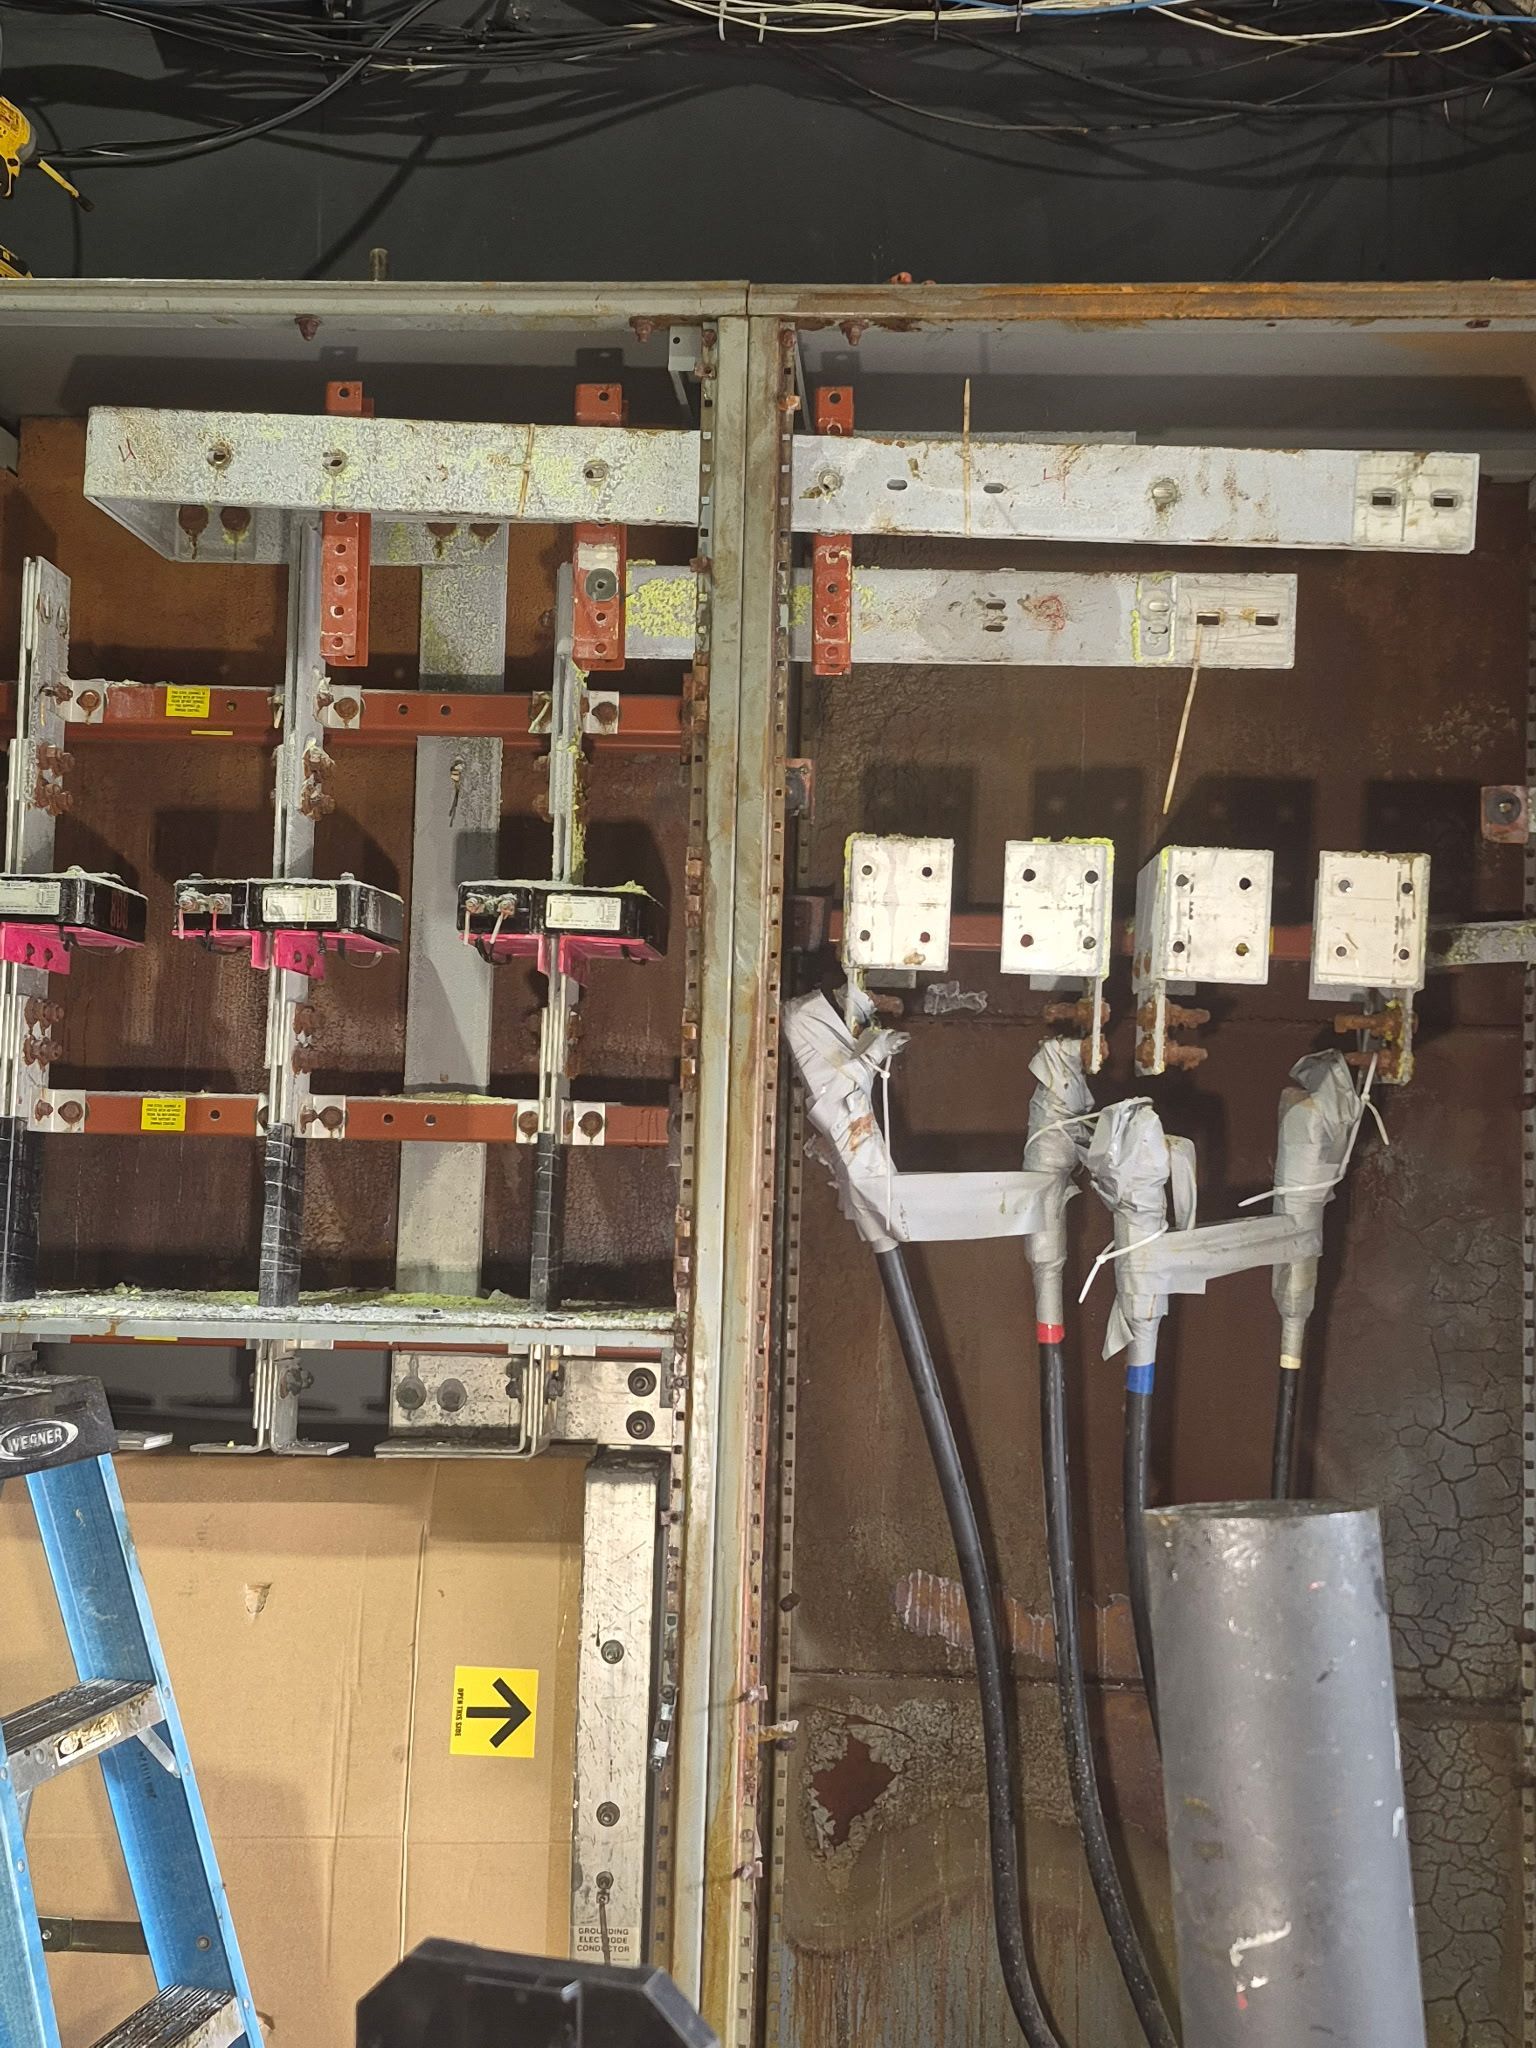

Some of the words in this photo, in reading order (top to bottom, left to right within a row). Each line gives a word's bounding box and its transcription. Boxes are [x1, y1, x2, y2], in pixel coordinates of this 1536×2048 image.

[7, 1427, 63, 1452] WERNER
[578, 1927, 629, 1935] GROUDING
[579, 1936, 628, 1944] ELECODE
[577, 1944, 630, 1952] CONDCTOR
